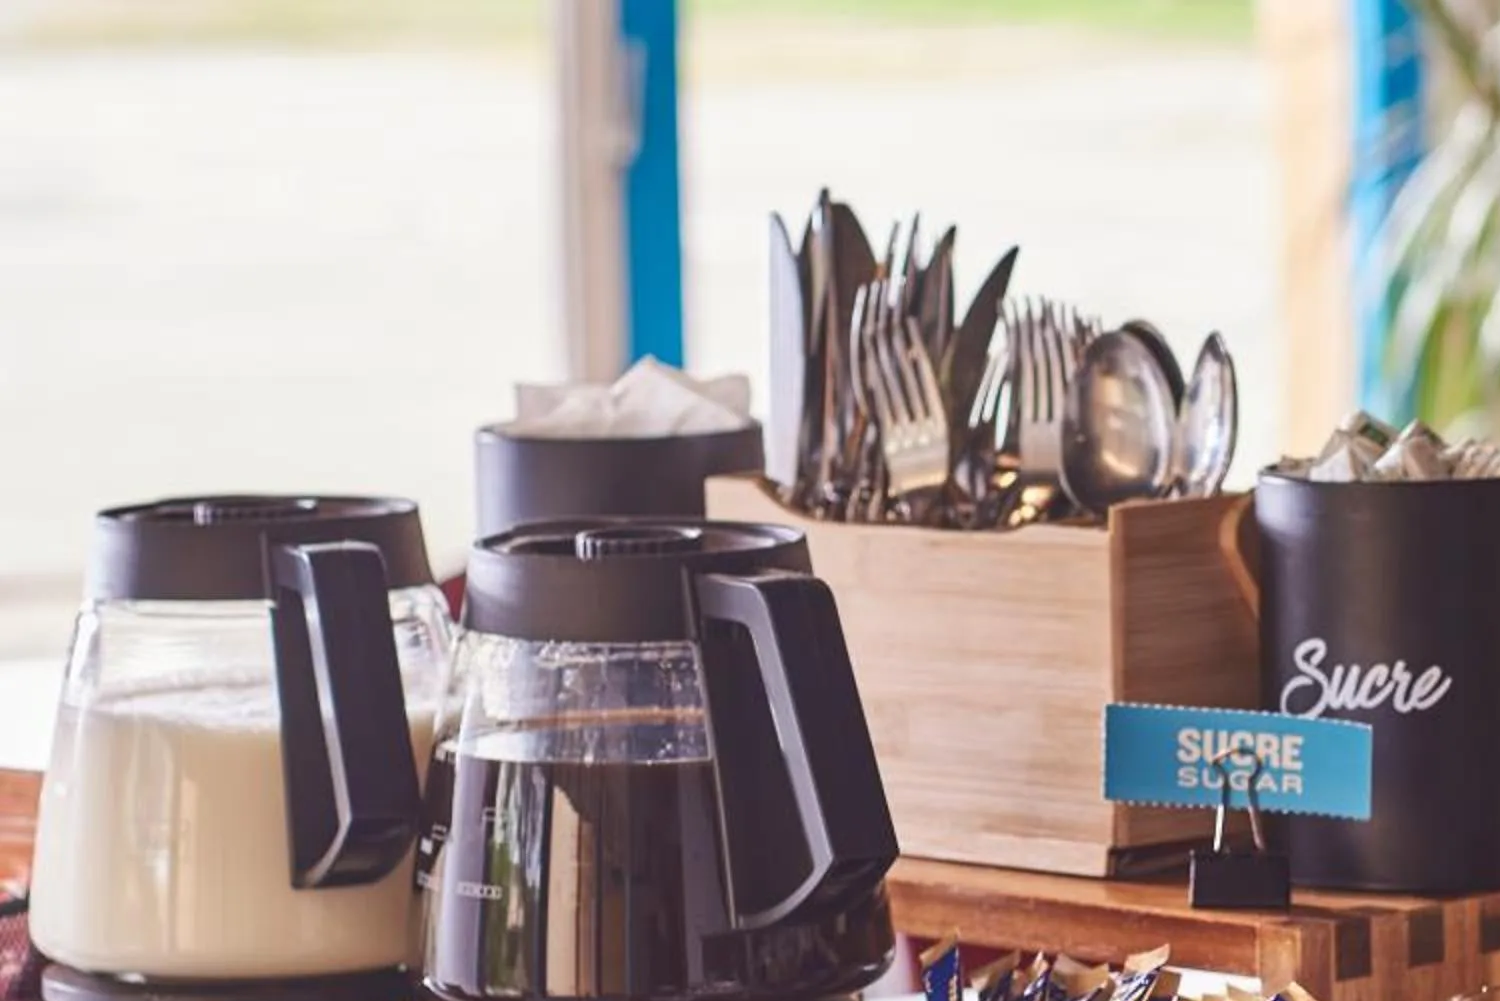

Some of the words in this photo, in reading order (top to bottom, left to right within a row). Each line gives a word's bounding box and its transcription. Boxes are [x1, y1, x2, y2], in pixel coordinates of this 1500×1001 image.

[1280, 637, 1452, 719] Sucre
[1177, 727, 1304, 770] SUCRE
[1177, 765, 1303, 795] SUGAR
